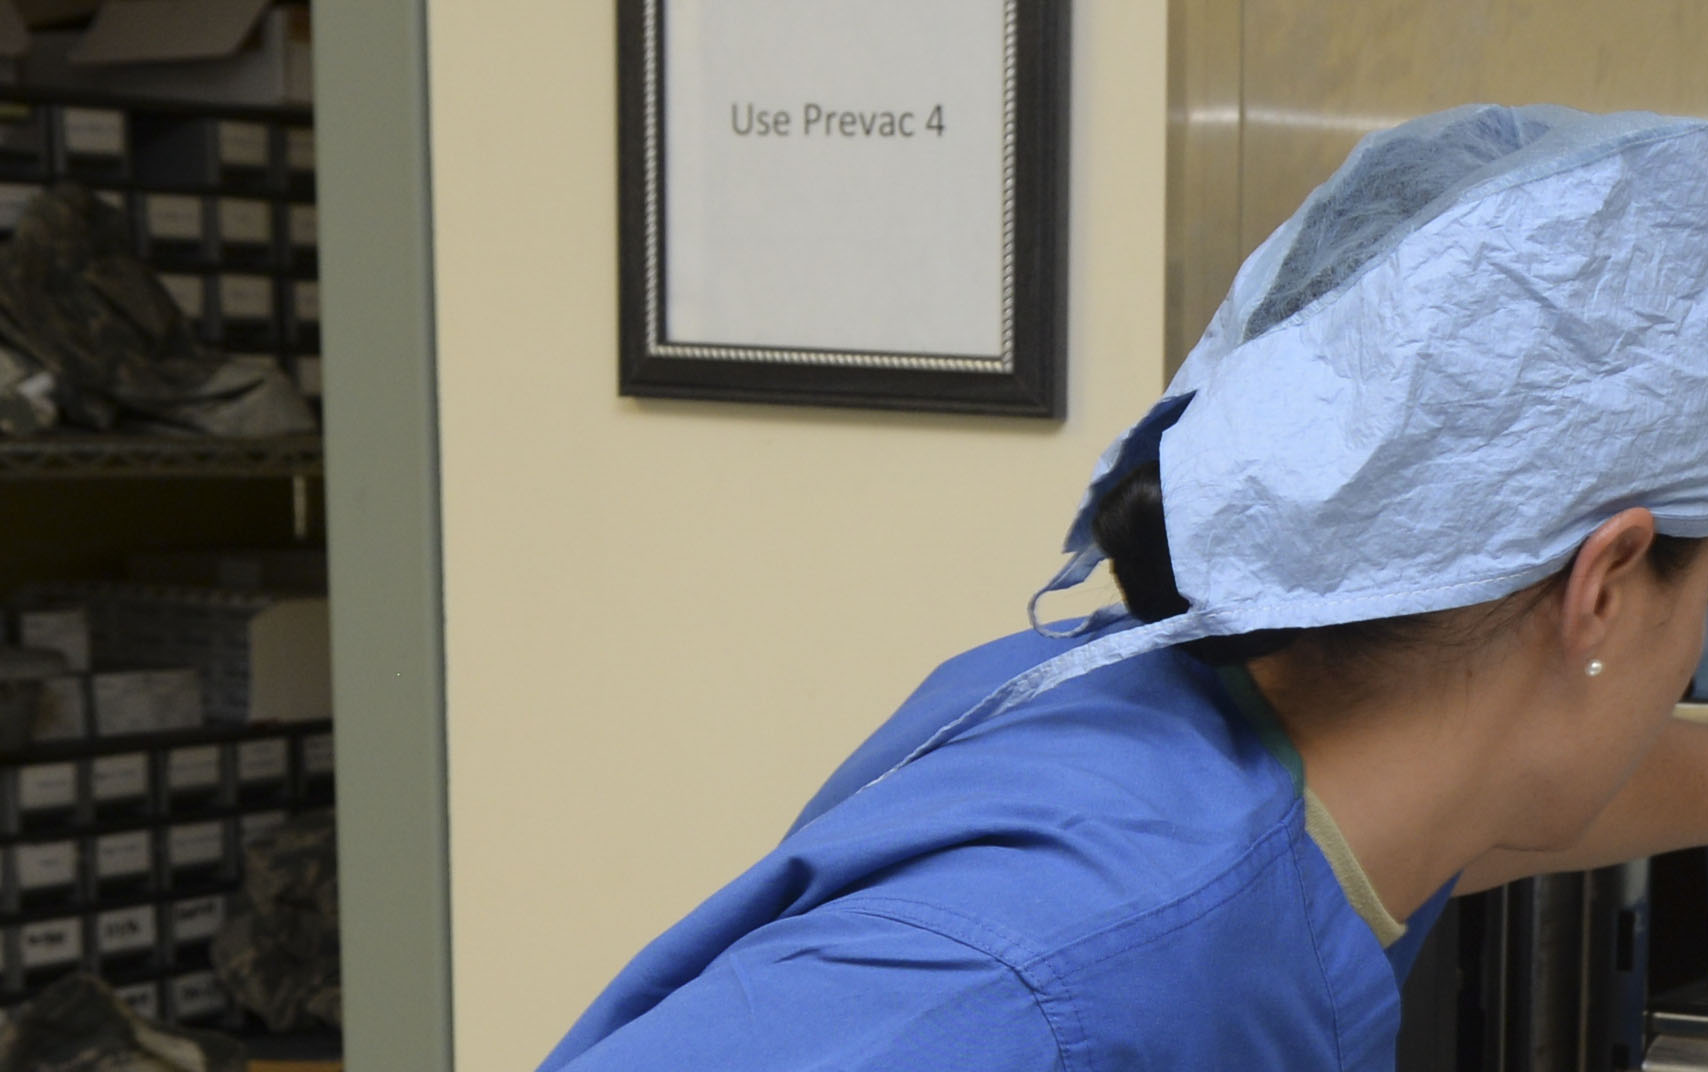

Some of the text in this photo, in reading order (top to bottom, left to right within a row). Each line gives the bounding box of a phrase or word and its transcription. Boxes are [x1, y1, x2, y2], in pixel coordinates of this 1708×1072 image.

[731, 103, 946, 138] Use Prevac 4
